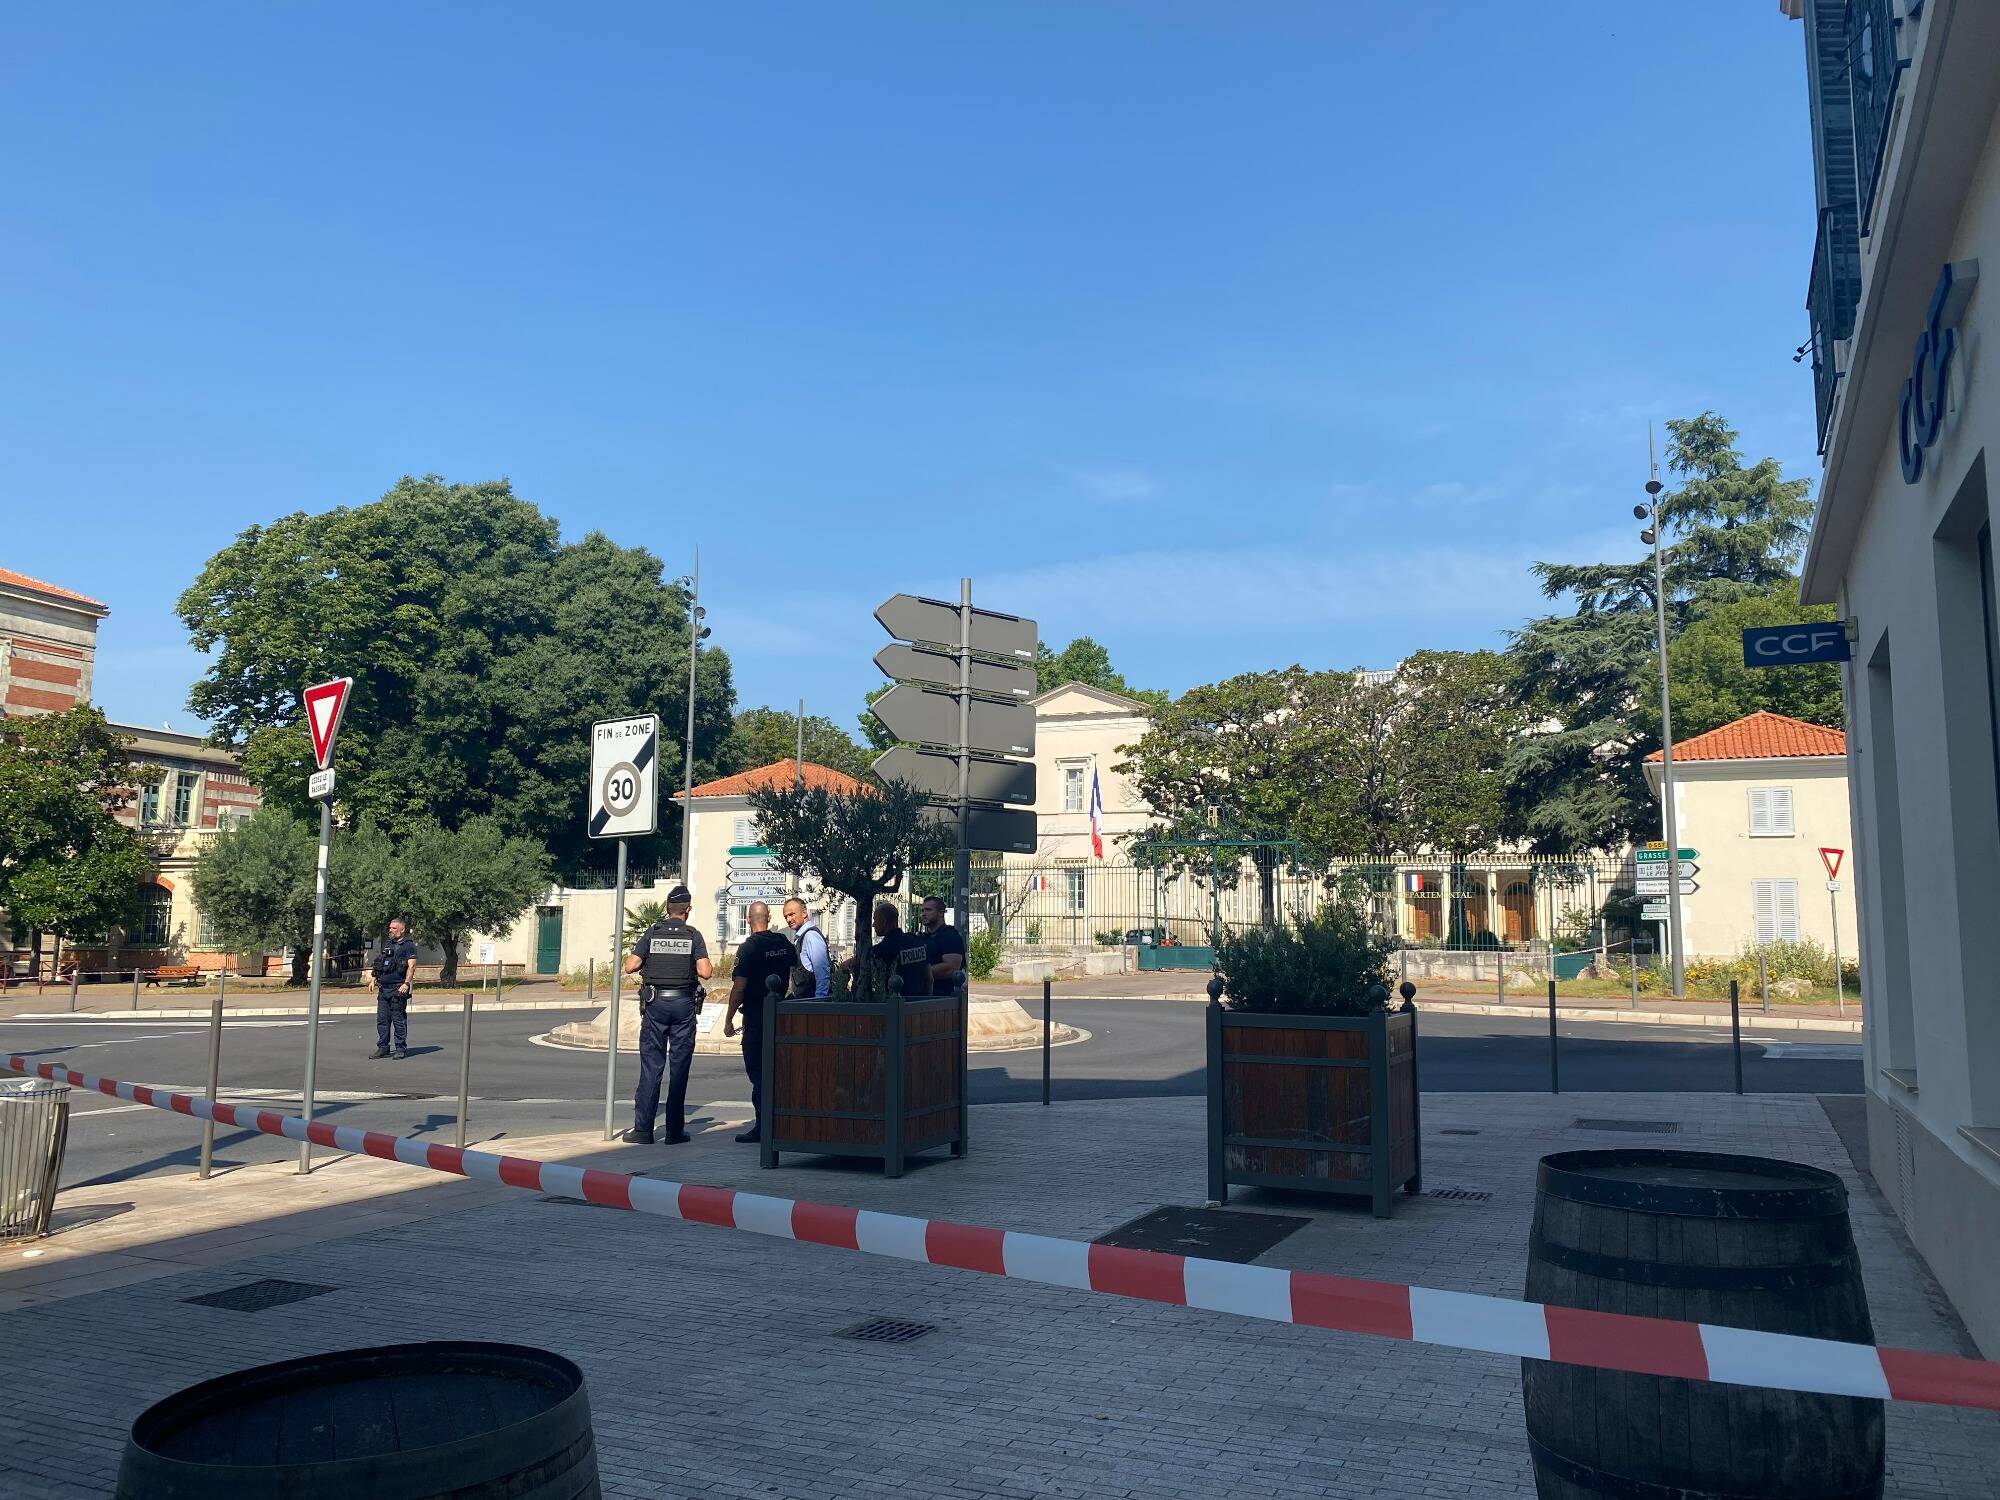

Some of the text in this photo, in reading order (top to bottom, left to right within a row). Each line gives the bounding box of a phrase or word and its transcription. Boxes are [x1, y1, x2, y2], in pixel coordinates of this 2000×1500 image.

[1754, 631, 1838, 656] CCF
[597, 728, 613, 740] FIN
[625, 723, 650, 736] ZONE
[610, 778, 633, 801] 30
[652, 940, 690, 948] POLICE
[765, 948, 788, 959] POLICE
